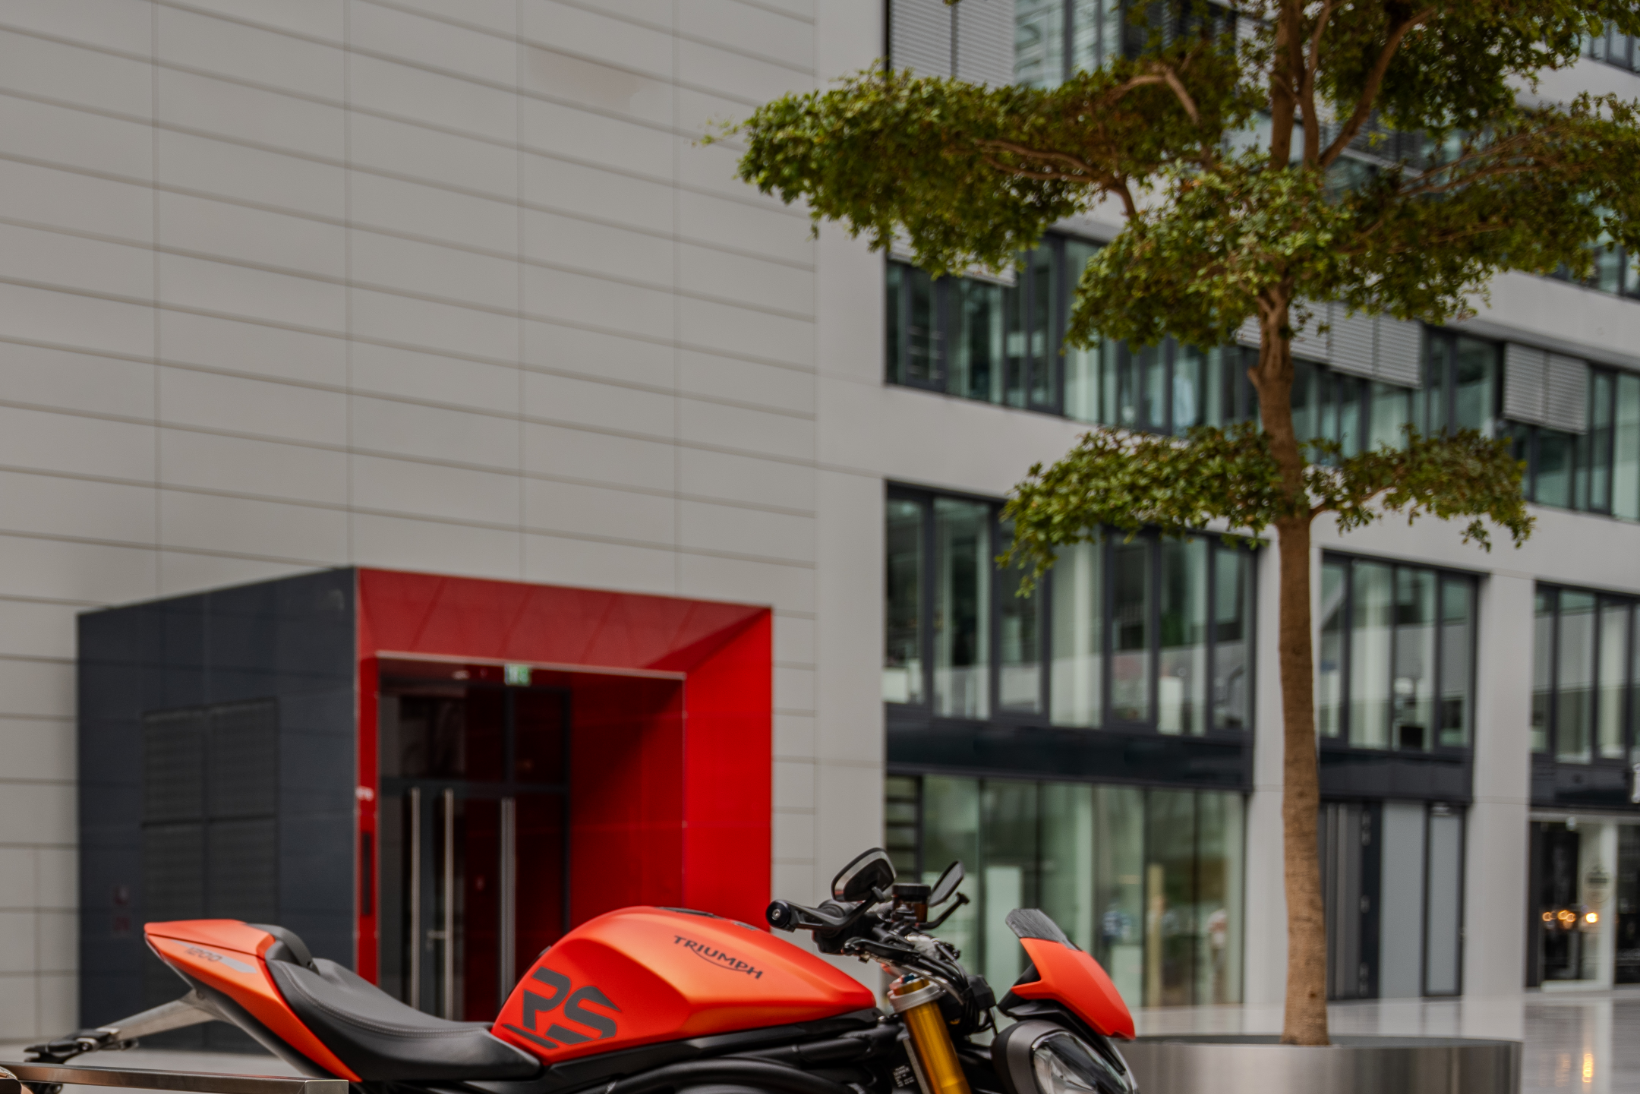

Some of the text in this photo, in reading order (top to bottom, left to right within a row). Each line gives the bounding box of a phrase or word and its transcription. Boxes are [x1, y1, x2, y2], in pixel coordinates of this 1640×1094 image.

[184, 946, 223, 963] 1200
[674, 935, 763, 979] TRIUMPH
[523, 966, 622, 1046] RS
